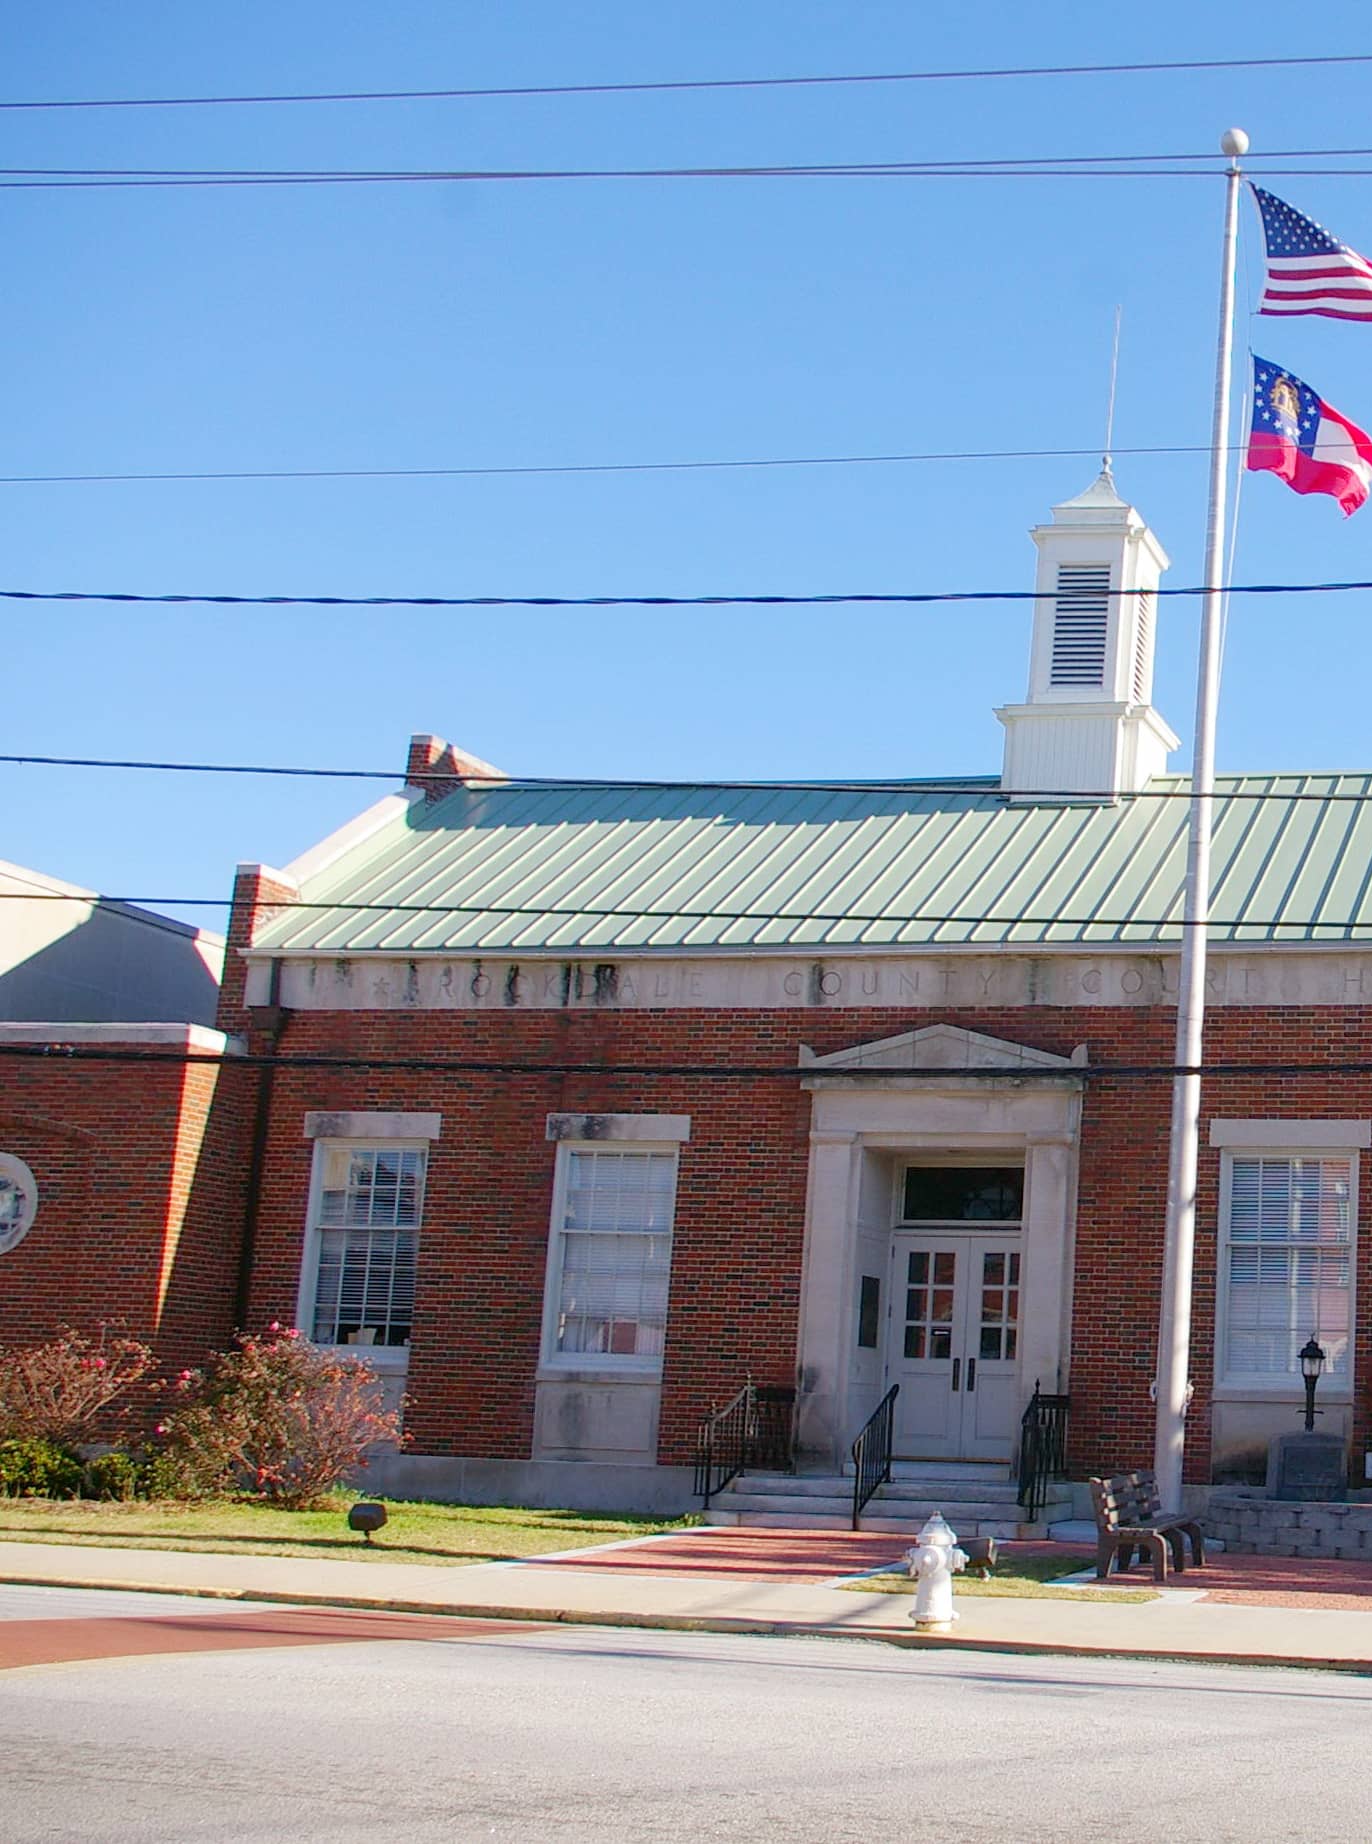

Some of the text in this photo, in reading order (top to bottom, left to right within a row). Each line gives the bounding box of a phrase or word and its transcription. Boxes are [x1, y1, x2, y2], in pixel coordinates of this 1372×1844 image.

[438, 971, 703, 998] ROCKDALE
[783, 970, 996, 996] COUNTY
[1081, 968, 1257, 994] COURT
